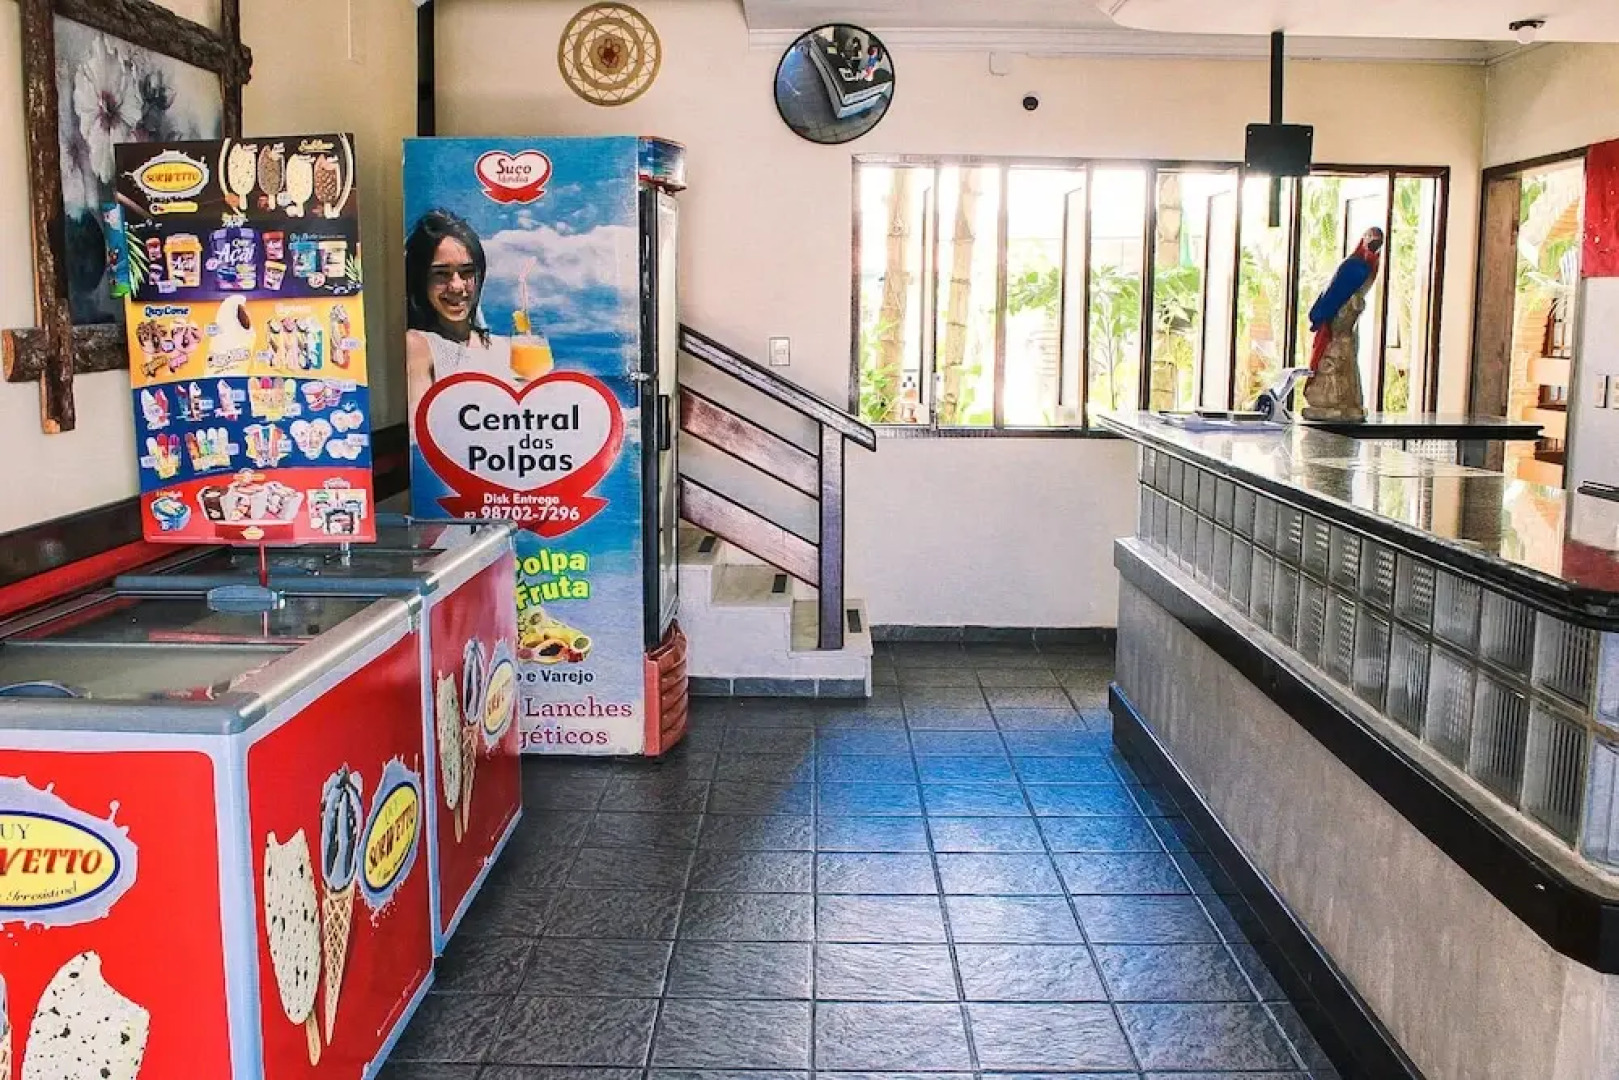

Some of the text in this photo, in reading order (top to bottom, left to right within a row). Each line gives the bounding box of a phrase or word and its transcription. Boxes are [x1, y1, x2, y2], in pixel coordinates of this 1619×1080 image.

[458, 404, 579, 431] Central
[519, 434, 553, 450] das
[468, 446, 573, 477] Polpas
[483, 493, 510, 504] Disk
[481, 506, 580, 521] 98702-7296
[541, 669, 594, 685] Varejo
[524, 697, 632, 717] Lanches
